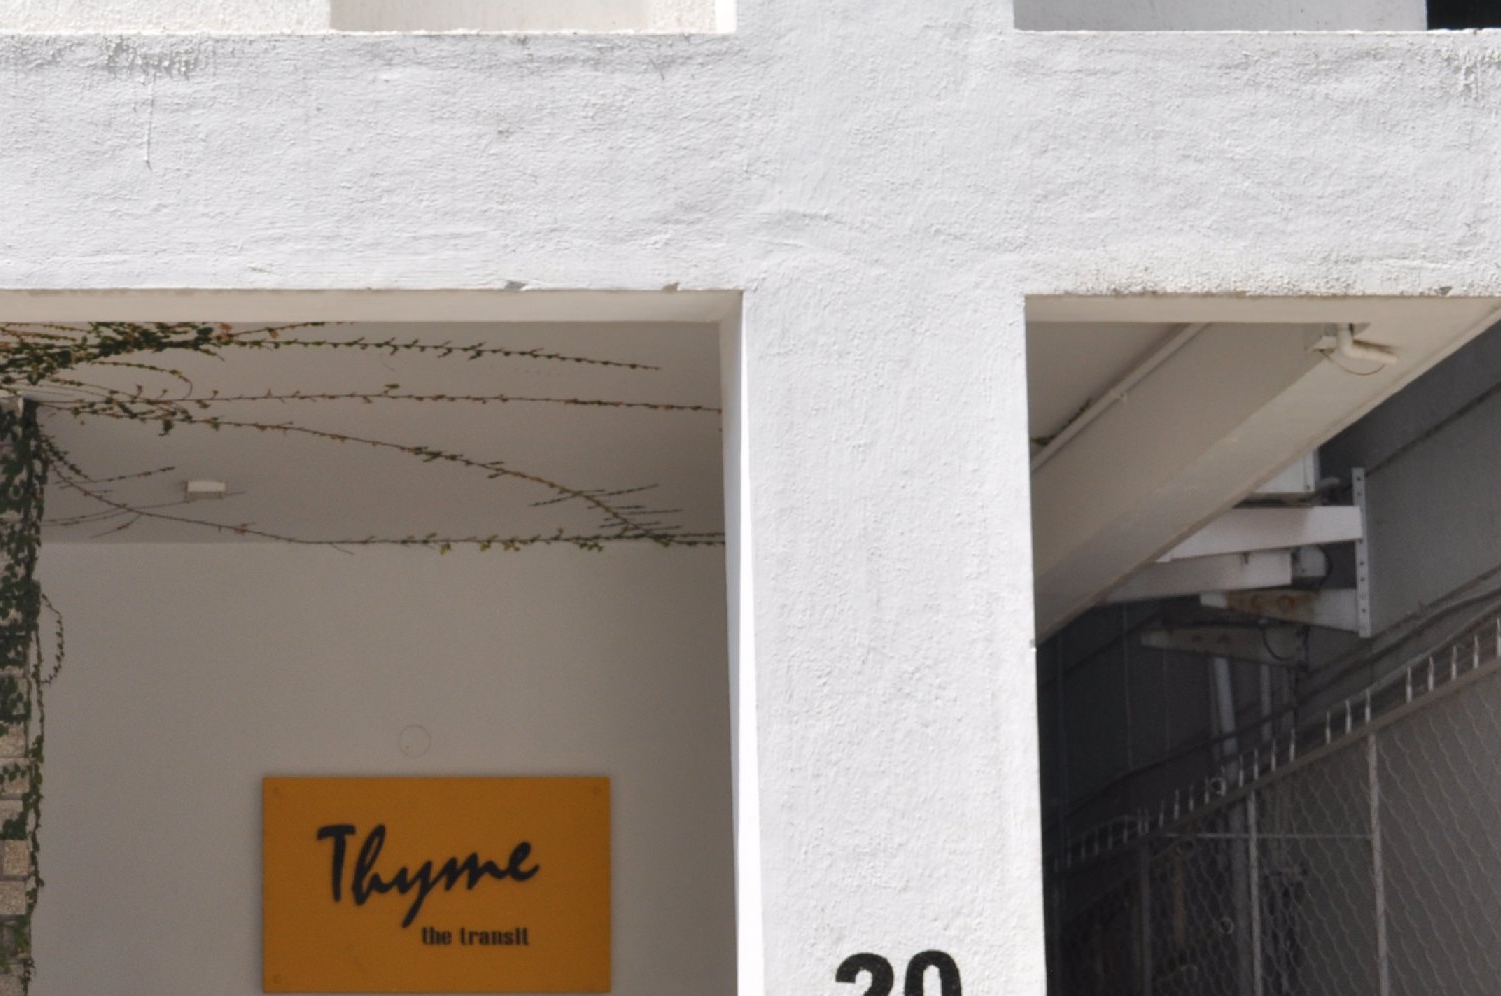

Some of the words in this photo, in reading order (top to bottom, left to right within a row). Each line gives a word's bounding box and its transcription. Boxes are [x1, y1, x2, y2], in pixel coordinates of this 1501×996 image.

[315, 822, 541, 930] Thyme
[420, 926, 453, 946] the
[459, 926, 530, 946] transit
